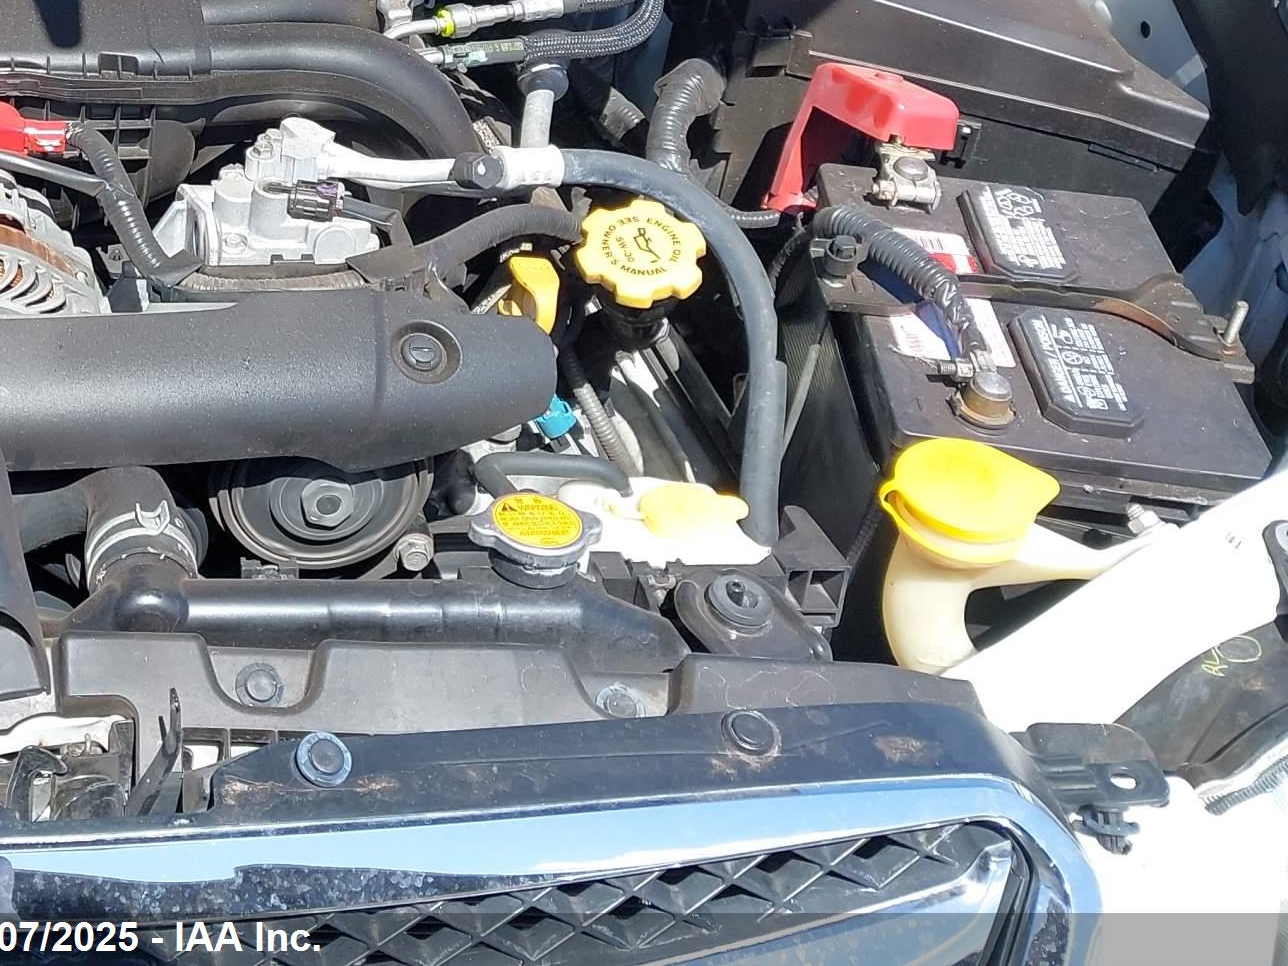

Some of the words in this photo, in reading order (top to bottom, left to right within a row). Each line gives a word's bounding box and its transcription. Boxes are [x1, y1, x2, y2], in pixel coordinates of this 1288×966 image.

[617, 216, 639, 226] SEE
[601, 224, 618, 266] OWNER'S
[647, 217, 681, 246] ENGINE
[669, 249, 681, 263] OIL
[620, 266, 667, 276] MANUAL
[1032, 319, 1055, 351] POISON
